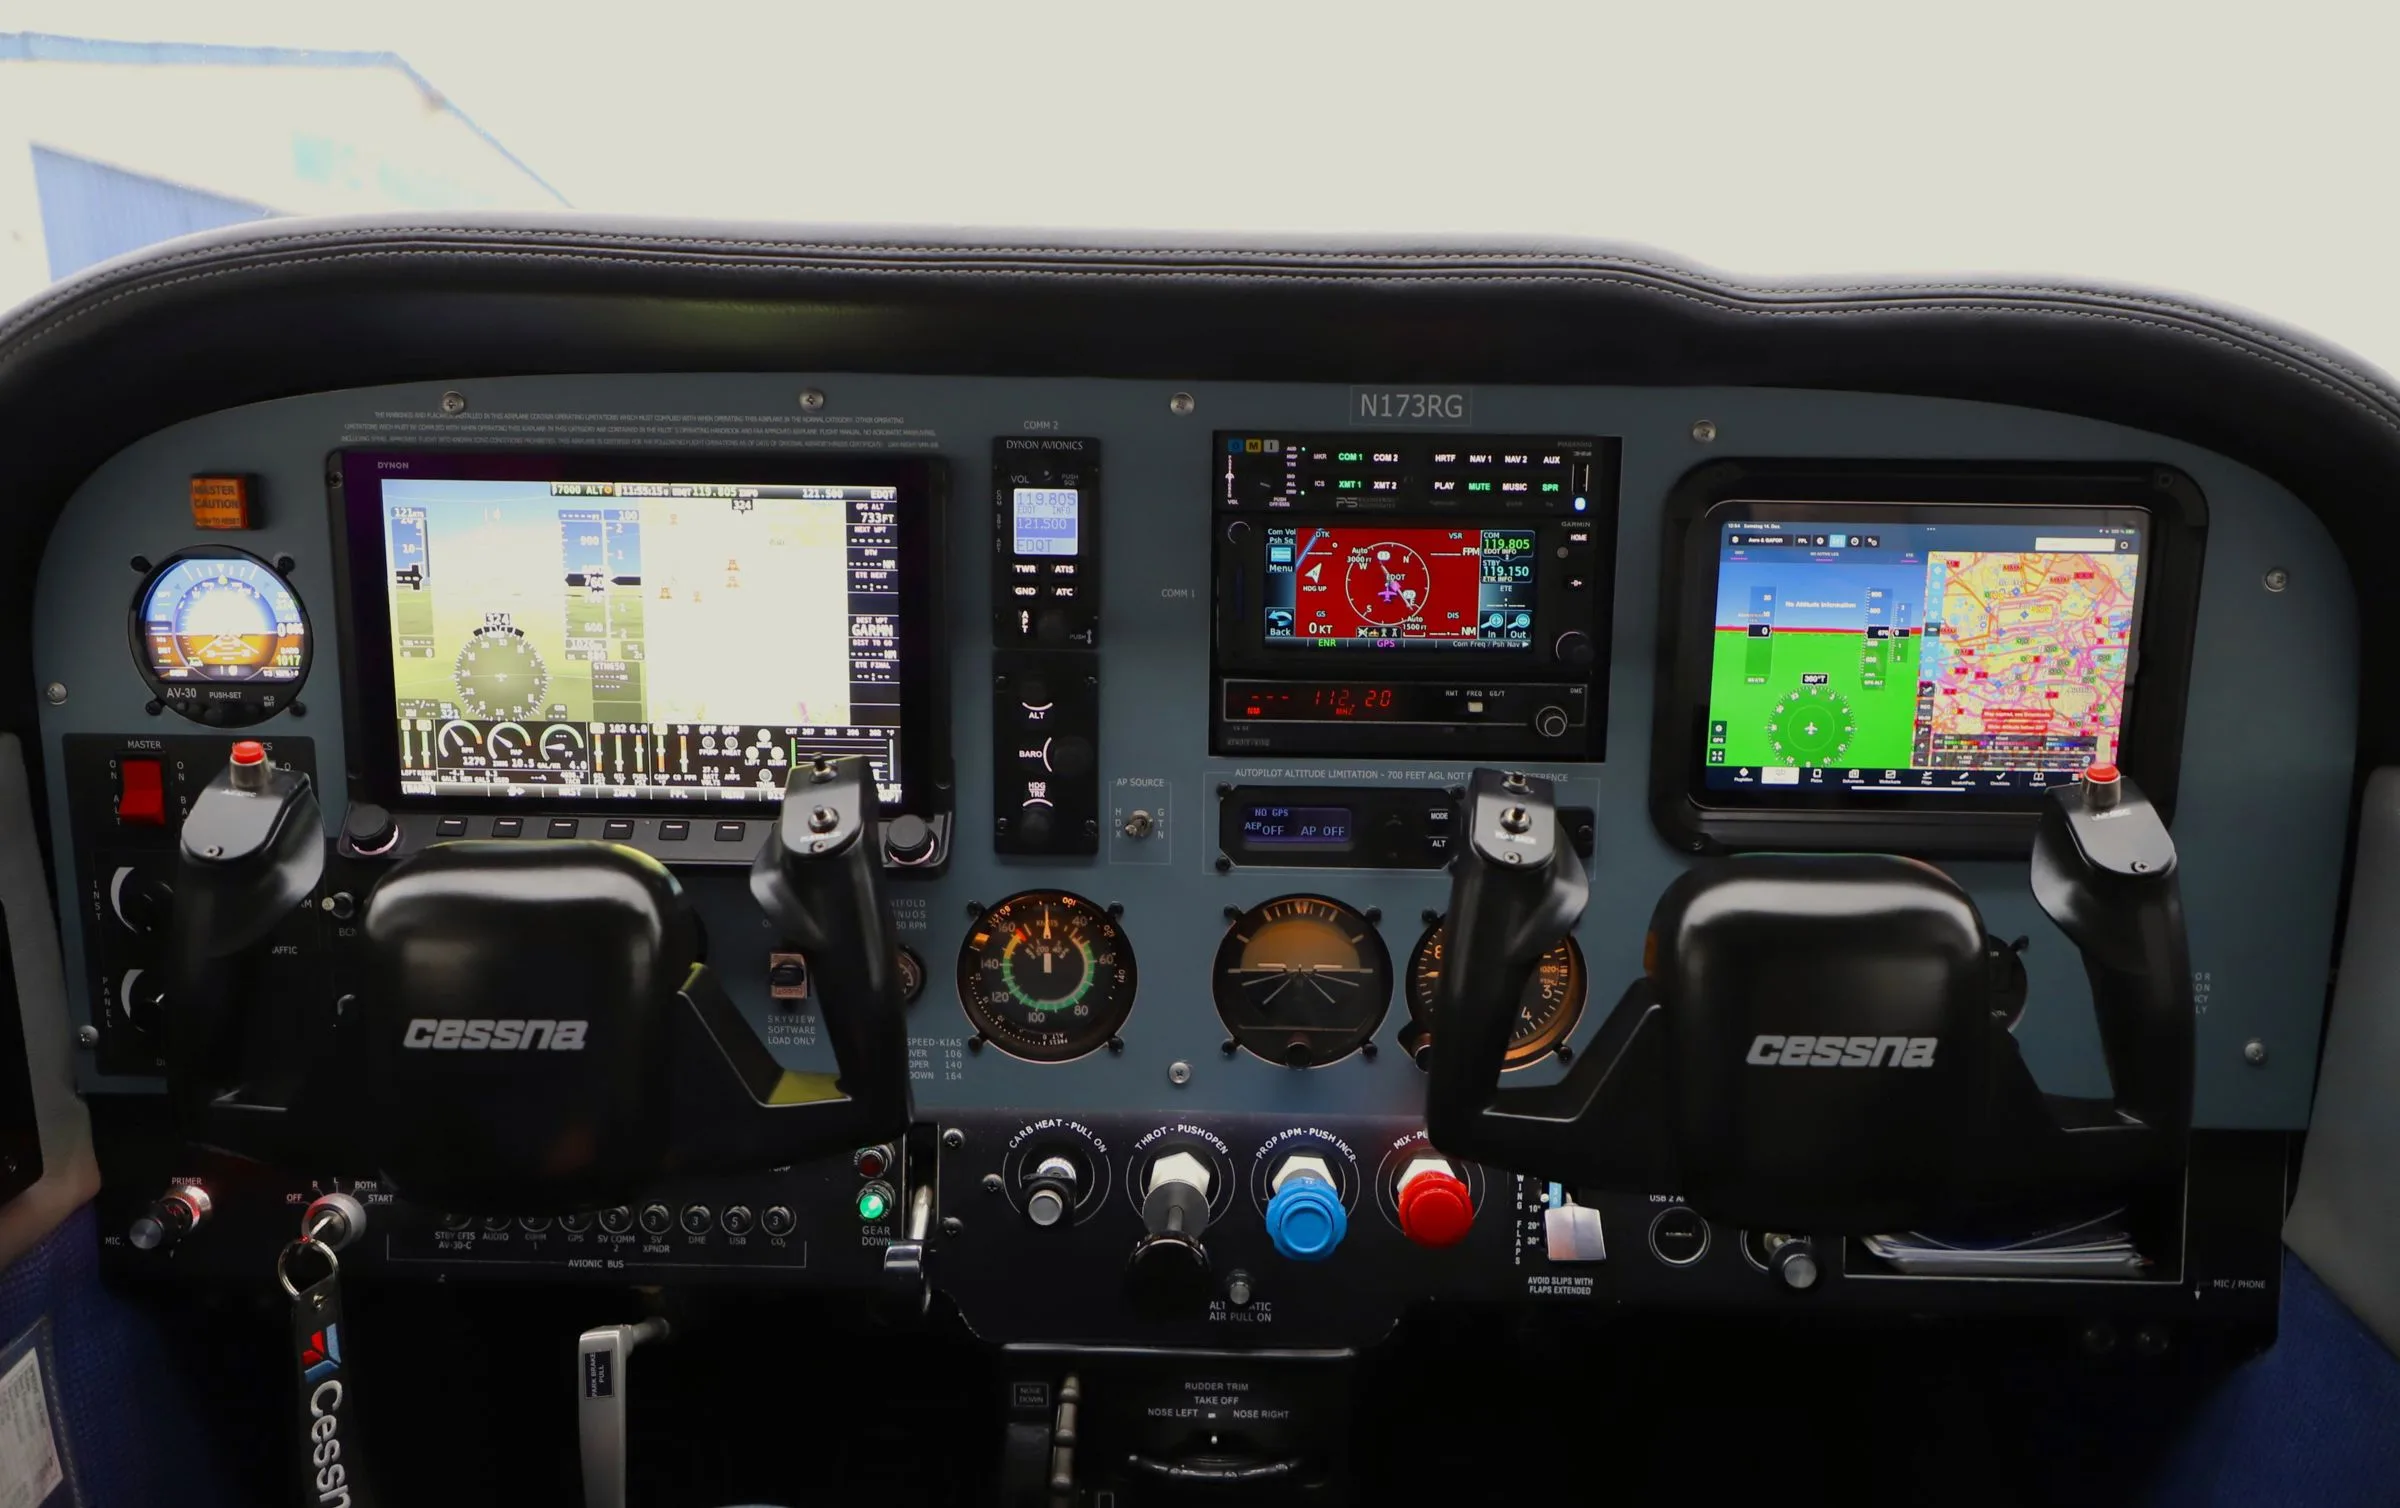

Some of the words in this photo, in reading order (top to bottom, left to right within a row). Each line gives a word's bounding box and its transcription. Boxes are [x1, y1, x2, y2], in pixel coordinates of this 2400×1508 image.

[1361, 394, 1463, 418] N173RG
[1024, 420, 1050, 430] COMM
[1054, 420, 1058, 430] 2
[1006, 440, 1039, 449] DYNON
[1041, 441, 1083, 451] AVIONICS
[1338, 454, 1358, 462] COM
[1358, 454, 1363, 462] 1
[1373, 454, 1392, 462] COM
[1393, 454, 1398, 462] 2
[1434, 454, 1456, 462] HRTF
[1470, 455, 1486, 463] NAV
[1487, 455, 1492, 463] 1
[1504, 456, 1520, 464] NAV
[1522, 456, 1528, 464] 2
[1543, 456, 1560, 465] AUX
[378, 461, 410, 470] DYNON
[1010, 475, 1030, 484] VOL
[1338, 480, 1356, 488] XMT
[1358, 480, 1362, 488] 1
[1374, 482, 1391, 490] XMT
[1392, 482, 1397, 490] 2
[1434, 482, 1455, 490] PLAY
[1468, 482, 1490, 491] MUTE
[1502, 483, 1528, 492] MUSIC
[1542, 484, 1559, 492] SPR
[194, 498, 240, 509] CAUTION
[1017, 492, 1076, 506] 119.805
[1018, 518, 1067, 530] 121.500
[1570, 534, 1588, 542] HOME
[1016, 539, 1052, 552] EDQT
[1484, 539, 1530, 550] 119.805
[1462, 546, 1480, 556] FPM
[1015, 564, 1036, 574] TWR
[1054, 564, 1074, 574] ATIS
[1269, 564, 1293, 572] Menu
[1484, 566, 1530, 578] 119.150
[1015, 587, 1036, 596] GND
[1056, 588, 1074, 596] ATC
[1162, 589, 1188, 598] COMM
[1021, 610, 1029, 634] APT
[1270, 628, 1291, 636] Back
[1308, 622, 1317, 634] 0
[1319, 625, 1333, 634] KT
[1462, 627, 1476, 636] NM
[1488, 630, 1496, 638] In
[1510, 630, 1526, 638] Out
[1318, 640, 1336, 648] ENR
[1376, 640, 1395, 648] GPS
[166, 686, 198, 699] AV-30
[208, 691, 242, 700] PUSH-SET
[1028, 712, 1045, 720] ALT
[127, 740, 162, 750] MASTER
[1018, 750, 1042, 758] BARO
[1234, 768, 1282, 778] AUTOPILOT
[1284, 769, 1326, 778] ALTITUDE
[1328, 770, 1379, 780] LIMITATION
[1388, 770, 1404, 780] 700
[1406, 770, 1427, 780] FEET
[1428, 771, 1446, 781] AGL
[1447, 772, 1466, 780] NOT
[1028, 782, 1046, 790] HDG
[1116, 778, 1128, 787] AP
[1130, 778, 1165, 788] SOURCE
[1255, 808, 1267, 817] NO
[1272, 808, 1289, 818] GPS
[1430, 812, 1448, 820] MODE
[1244, 821, 1262, 831] AEP
[1262, 824, 1284, 836] OFF
[1300, 825, 1317, 836] AP
[1322, 826, 1345, 837] OFF
[1432, 840, 1446, 848] ALT
[1072, 917, 1088, 928] 40
[998, 922, 1016, 933] 160
[1098, 954, 1114, 965] 60
[980, 959, 1000, 970] 140
[990, 992, 1010, 1003] 120
[1542, 986, 1552, 1000] 3
[1074, 1004, 1089, 1016] 80
[1520, 1006, 1533, 1021] 4
[768, 1015, 816, 1024] SKYVIEW
[1027, 1012, 1046, 1024] 100
[768, 1026, 816, 1035] SOFTWARE
[768, 1036, 791, 1045] LOAD
[793, 1036, 816, 1046] ONLY
[944, 1060, 962, 1070] 140
[1009, 1126, 1034, 1150] CARB
[1034, 1118, 1064, 1132] HEAT
[1094, 1138, 1108, 1154] ON
[1135, 1126, 1168, 1150] THROT
[1178, 1124, 1205, 1138] PUSH
[1204, 1132, 1229, 1155] OPEN
[1256, 1138, 1278, 1160] PROP
[1280, 1128, 1302, 1140] RPM
[1308, 1128, 1338, 1143] PUSH
[1335, 1140, 1357, 1164] INCR
[1393, 1134, 1412, 1150] MIX
[171, 1177, 202, 1186] PRIMER
[354, 1181, 377, 1190] BOTH
[1516, 1174, 1525, 1210] WING
[286, 1194, 302, 1202] OFF
[368, 1194, 394, 1203] START
[1649, 1194, 1667, 1202] USB
[1668, 1194, 1674, 1202] 2
[862, 1226, 891, 1235] GEAR
[105, 1237, 121, 1246] MIC
[862, 1236, 891, 1246] DOWN
[1514, 1220, 1523, 1266] FLAPS
[568, 1259, 602, 1268] AVIONIC
[607, 1260, 624, 1268] BUS
[1528, 1276, 1550, 1286] AVOID
[1551, 1277, 1573, 1286] SLIPS
[1574, 1278, 1594, 1287] WITH
[2214, 1280, 2230, 1288] MIC
[2238, 1280, 2266, 1289] PHONE
[1529, 1286, 1552, 1295] FLAPS
[1554, 1286, 1592, 1296] EXTENDED
[1210, 1312, 1227, 1322] AIR
[1230, 1313, 1254, 1322] PULL
[1257, 1312, 1272, 1322] ON
[1184, 1382, 1224, 1391] RUDDER
[1226, 1382, 1249, 1392] TRIM
[1194, 1396, 1218, 1405] TAKE
[1220, 1396, 1239, 1405] OFF
[1147, 1408, 1173, 1416] NOSE
[1175, 1408, 1198, 1417] LEFT
[1233, 1410, 1260, 1418] NOSE
[1262, 1410, 1290, 1419] RIGHT
